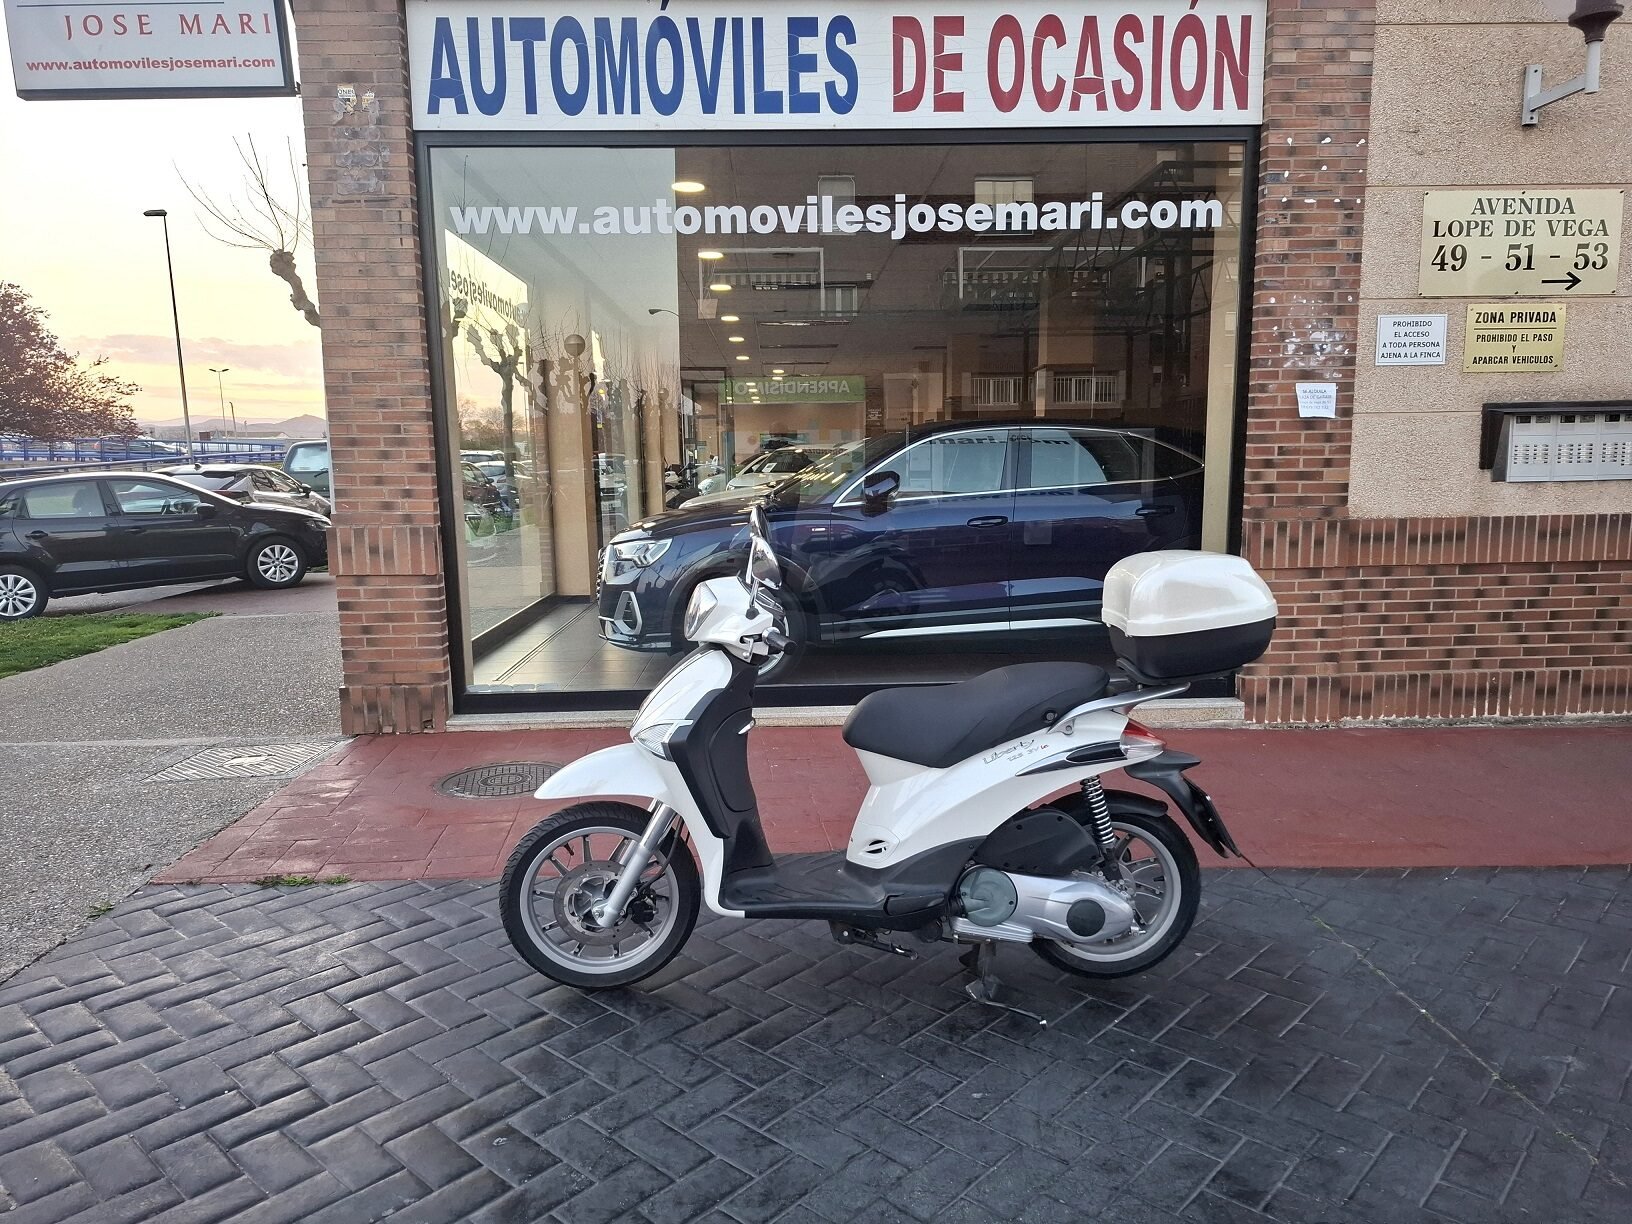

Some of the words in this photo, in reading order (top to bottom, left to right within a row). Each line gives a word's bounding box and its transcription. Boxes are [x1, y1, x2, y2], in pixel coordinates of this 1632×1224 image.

[64, 14, 153, 40] JOSE
[179, 13, 272, 35] MARI
[25, 56, 276, 72] www.automovilesjosemari.com
[427, 0, 858, 116] AUTOMÓVILES
[892, 15, 965, 113] DE
[987, 0, 1252, 113] OCASIÓN
[1471, 197, 1576, 215] AVENIDA
[449, 191, 1223, 240] www.automovilesjosemari.com
[1432, 219, 1494, 238] LOPE
[1504, 219, 1536, 237] DE
[1546, 218, 1609, 237] VEGA
[1431, 244, 1468, 271] 49
[1505, 243, 1537, 271] 51
[1573, 242, 1609, 270] 53
[1392, 320, 1433, 328] PROHIBIDO
[1475, 312, 1505, 324] ZONA
[1510, 311, 1557, 323] PRIVADA
[1476, 333, 1518, 343] PROHIBIDO
[1520, 333, 1530, 342] EL
[1532, 333, 1553, 342] PASO
[1511, 344, 1517, 353] Y
[1472, 356, 1509, 365] APARCAR
[1512, 355, 1554, 364] VEHICULOS
